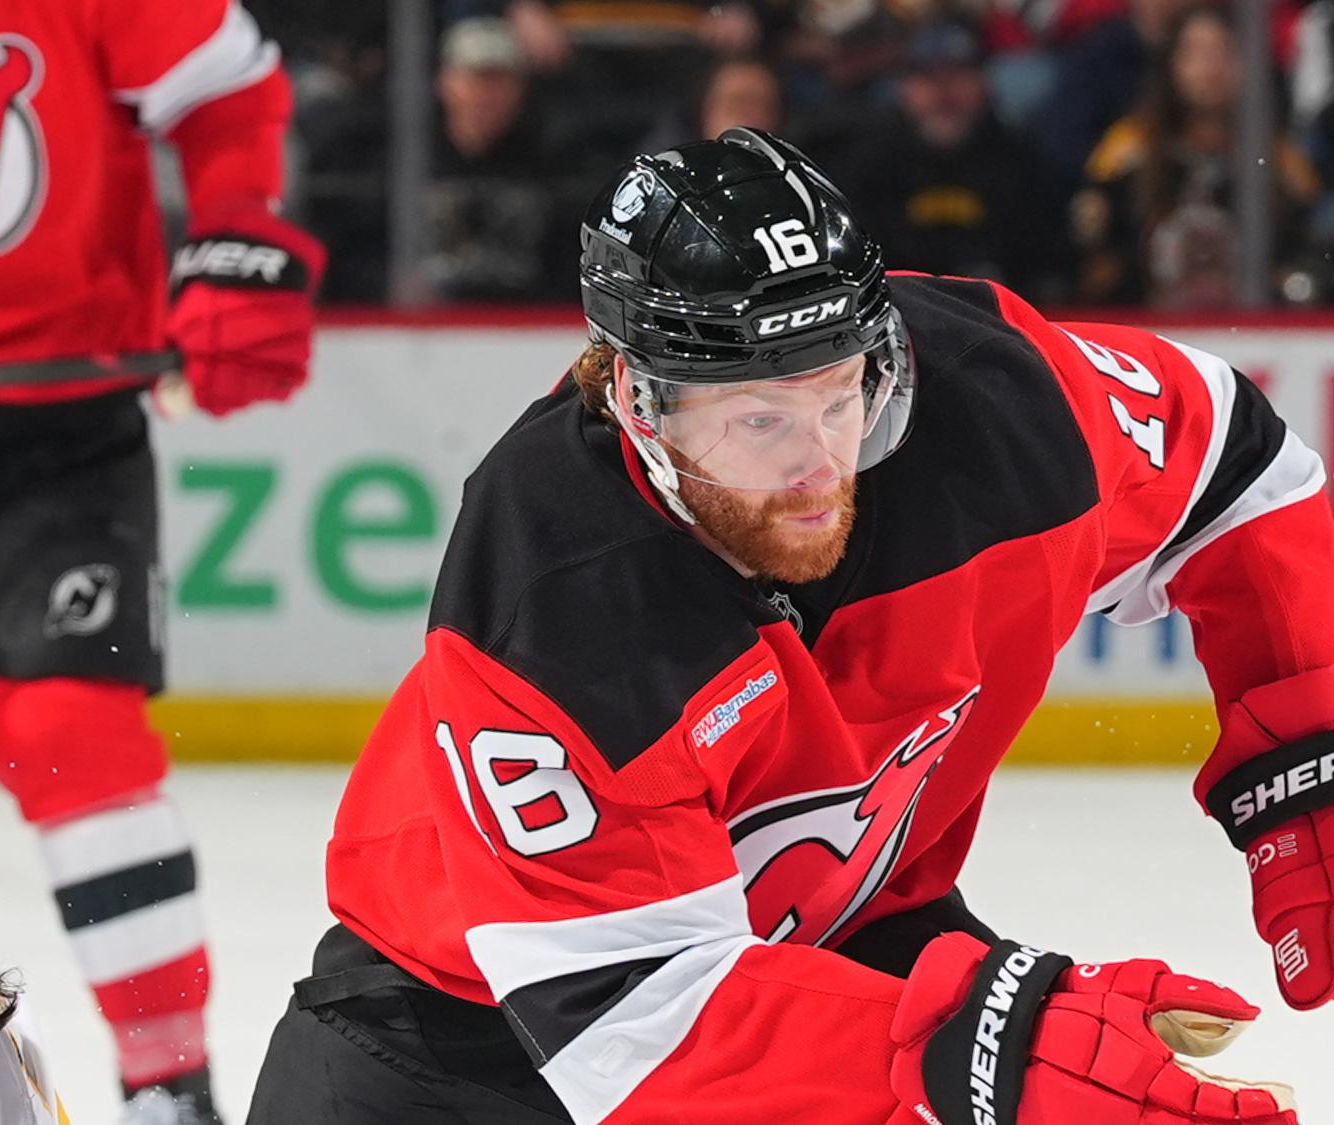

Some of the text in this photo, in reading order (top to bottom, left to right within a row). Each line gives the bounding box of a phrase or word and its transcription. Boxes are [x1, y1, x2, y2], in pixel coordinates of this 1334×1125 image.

[753, 219, 819, 274] 16
[758, 297, 848, 335] CCM
[435, 719, 602, 859] 16
